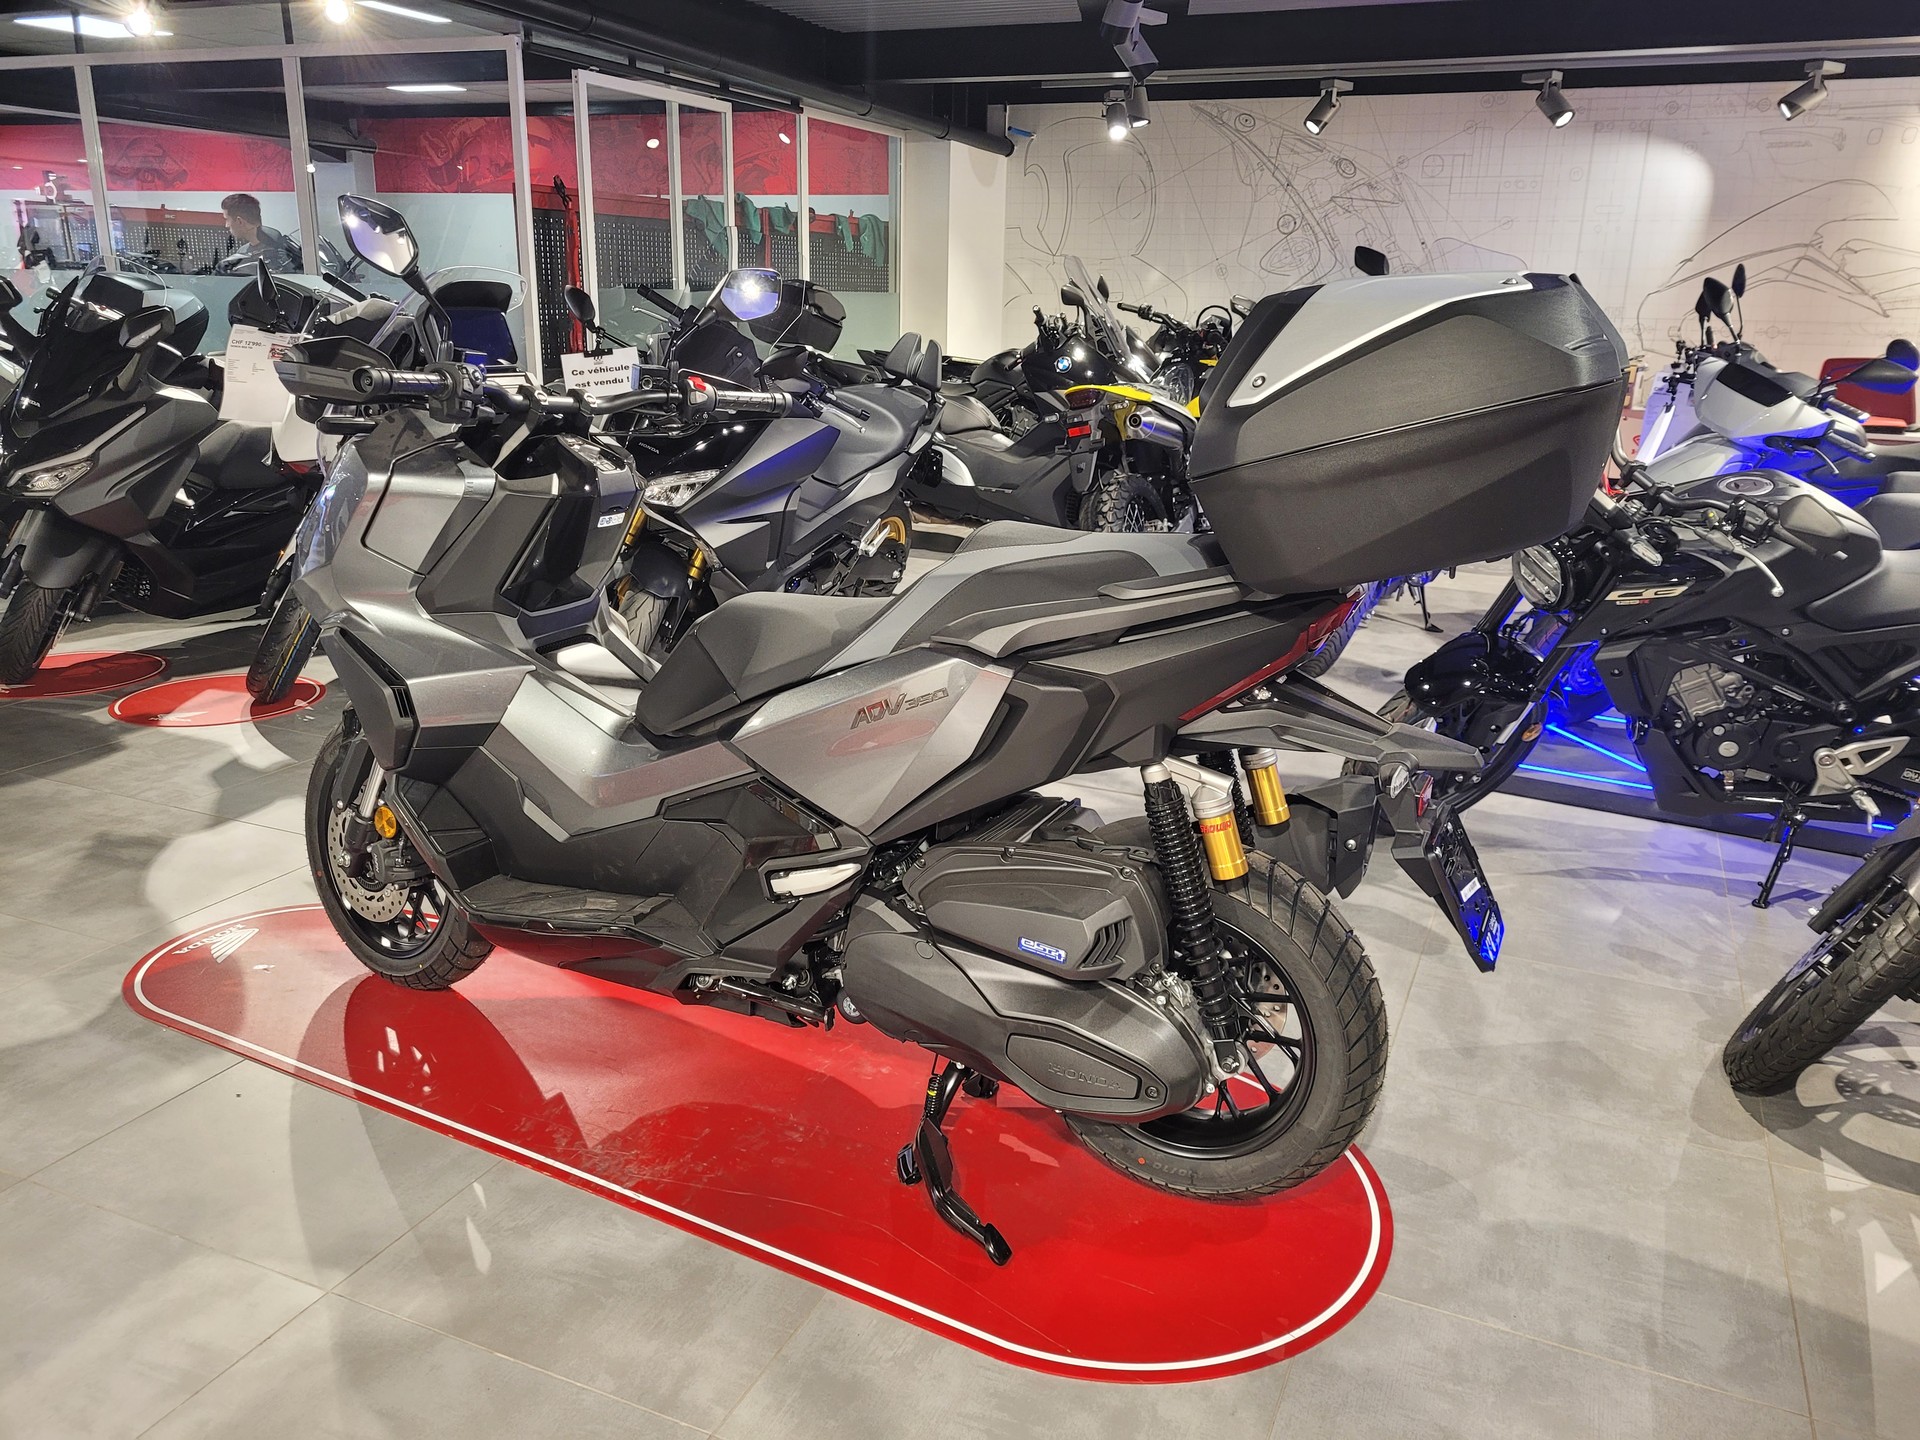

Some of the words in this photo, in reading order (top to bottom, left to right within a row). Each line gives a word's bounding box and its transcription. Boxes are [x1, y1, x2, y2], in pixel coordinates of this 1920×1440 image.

[588, 364, 630, 375] véhicule
[575, 381, 591, 389] est
[593, 377, 624, 387] vendu
[638, 442, 660, 455] HONDA
[850, 692, 908, 730] ADV
[904, 687, 949, 711] 350
[1048, 1062, 1126, 1093] HONDA
